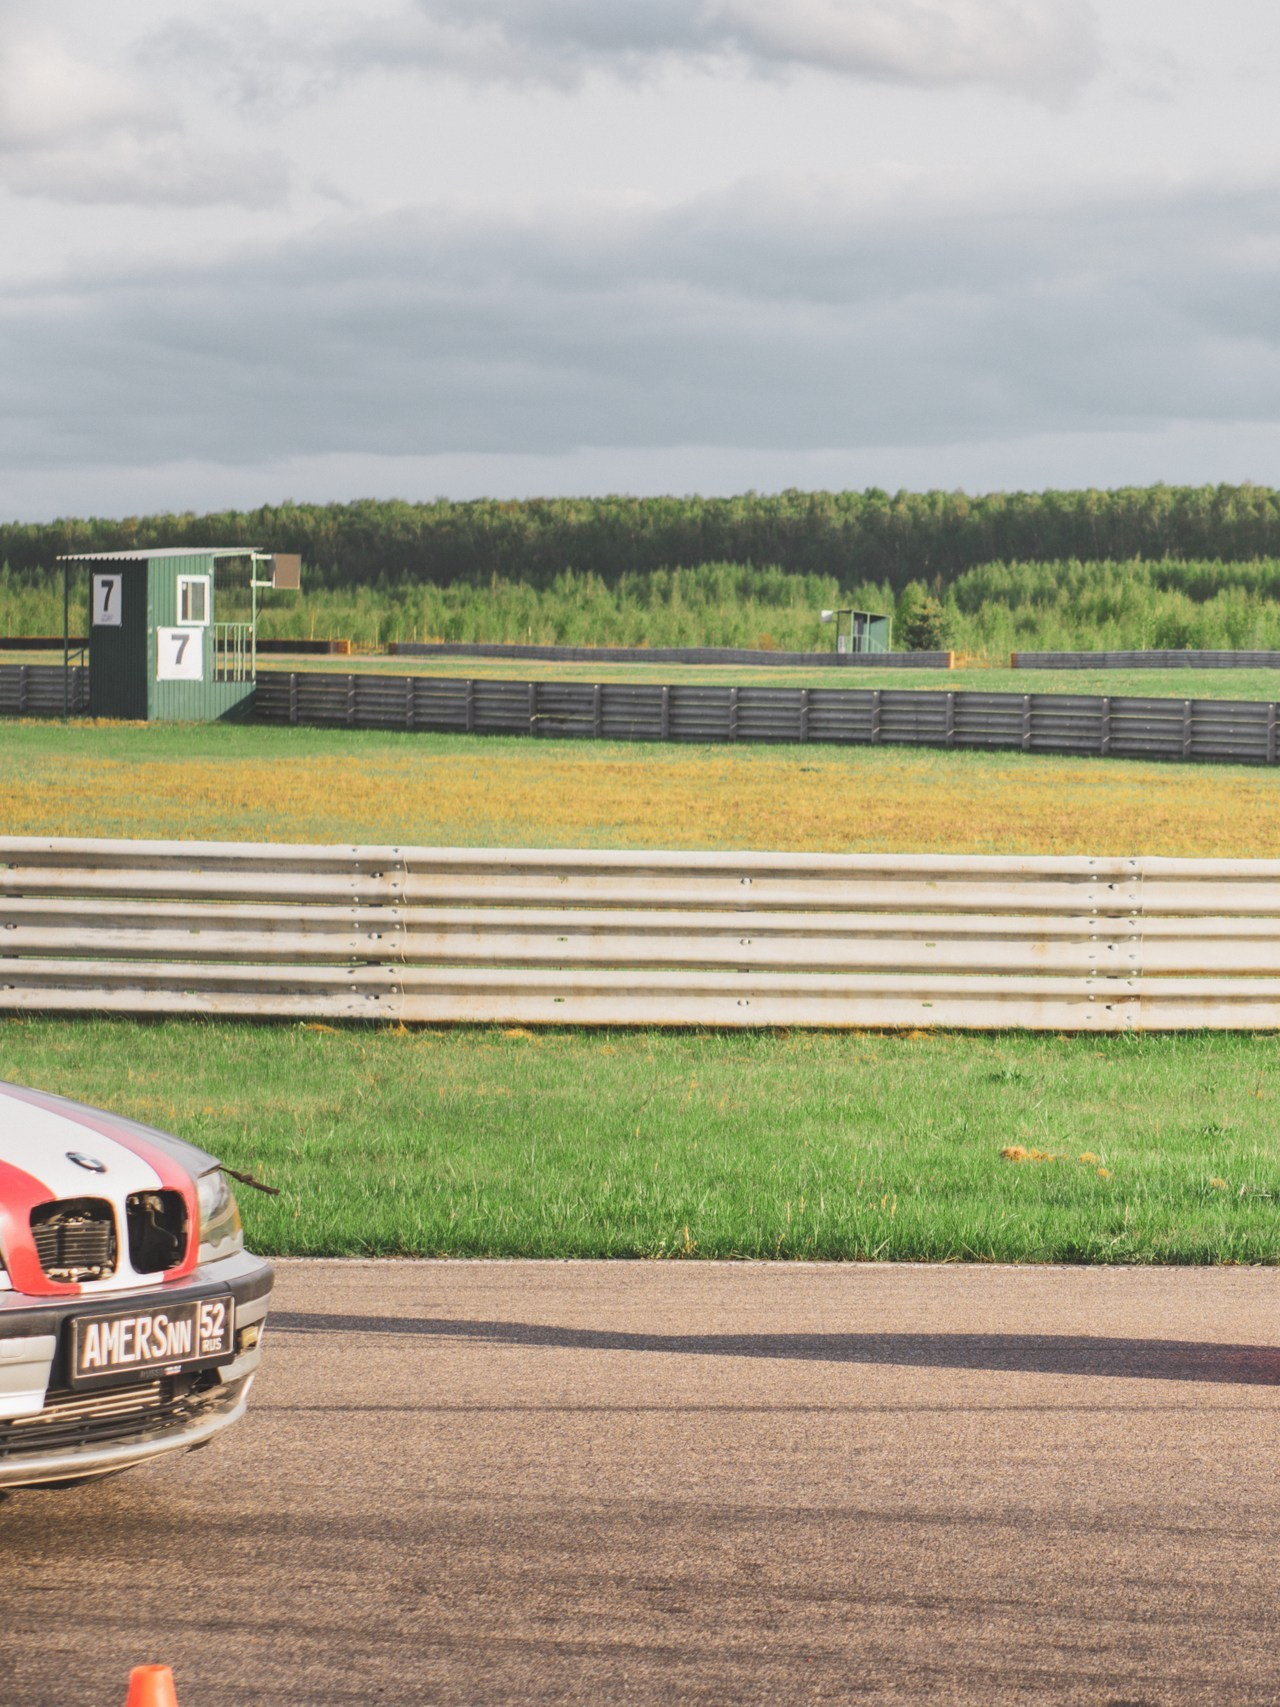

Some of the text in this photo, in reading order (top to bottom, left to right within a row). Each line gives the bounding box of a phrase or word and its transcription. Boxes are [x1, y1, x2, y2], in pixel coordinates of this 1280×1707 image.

[101, 580, 114, 612] 7
[171, 634, 190, 665] 7
[200, 1302, 225, 1338] 52
[202, 1338, 222, 1352] RUS
